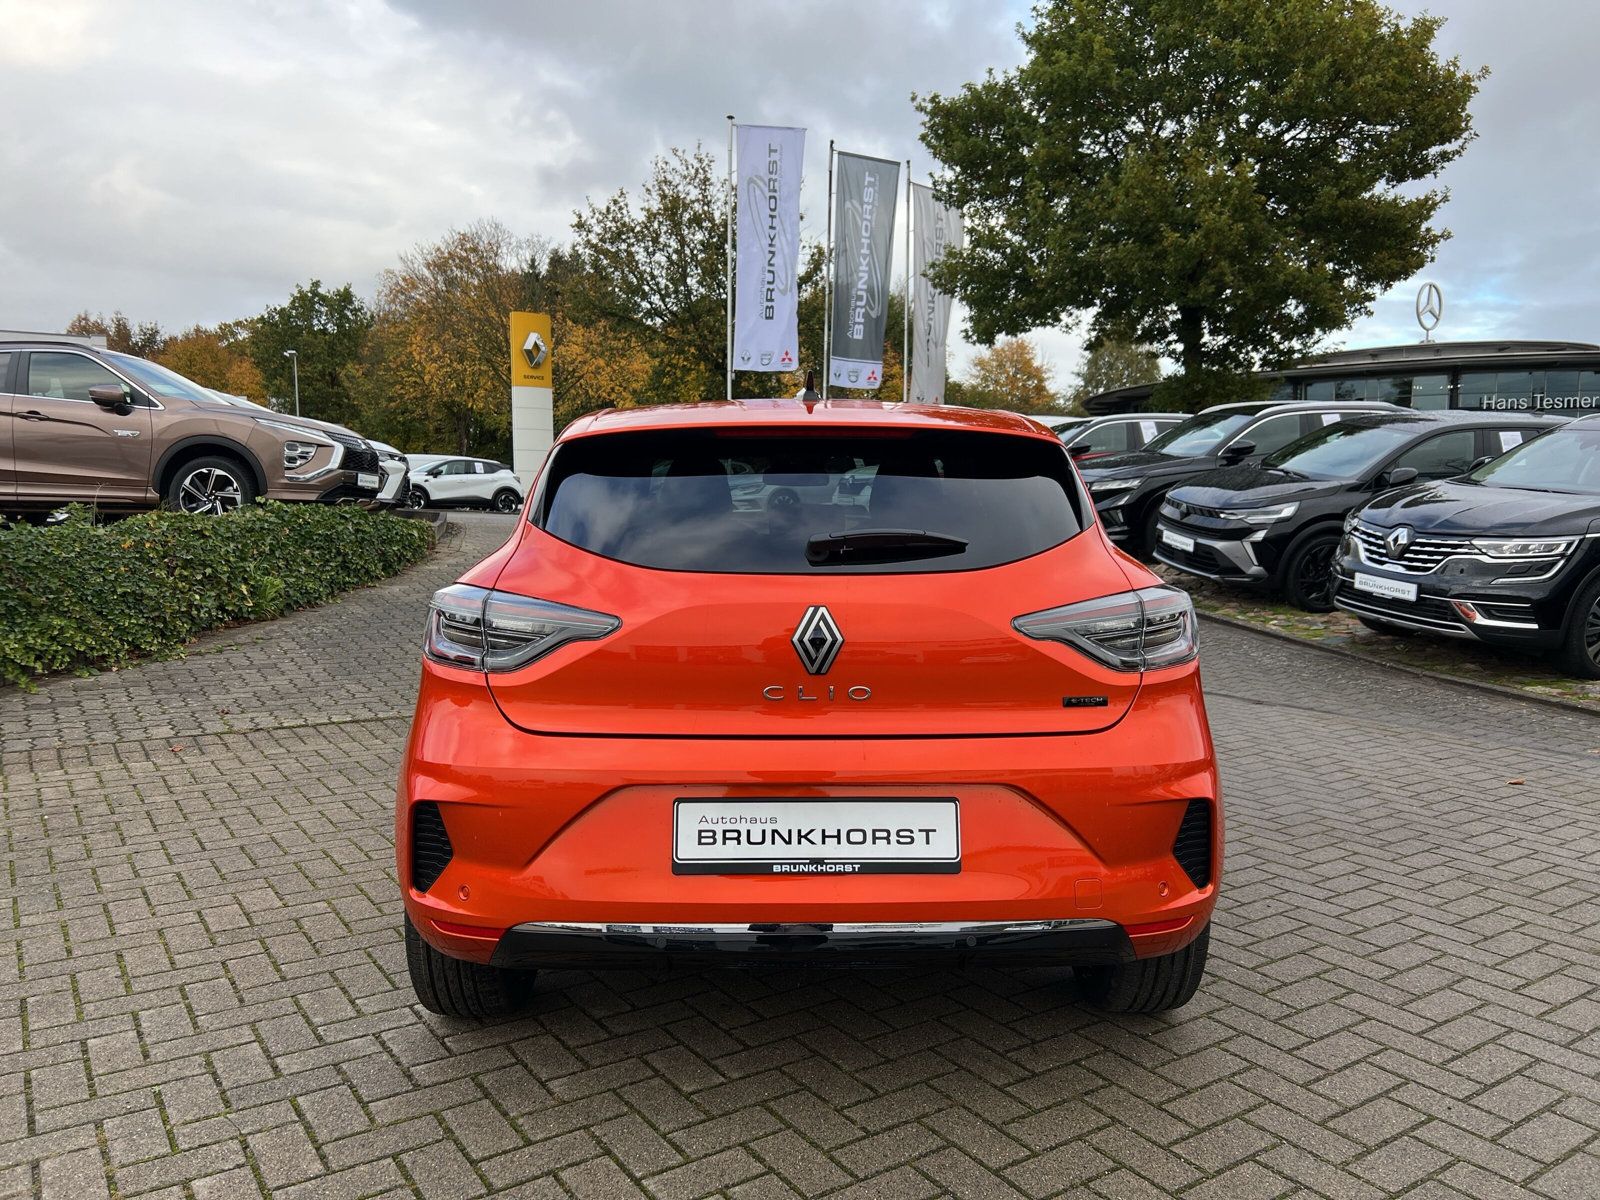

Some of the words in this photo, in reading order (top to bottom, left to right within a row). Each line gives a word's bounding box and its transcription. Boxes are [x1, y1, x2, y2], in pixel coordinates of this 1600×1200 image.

[764, 143, 778, 321] BRUNKHORST
[853, 171, 875, 340] BRUNKHORST
[846, 287, 857, 339] Autohaus
[1483, 394, 1528, 410] Hans
[1533, 393, 1600, 409] Tesmer
[1358, 580, 1411, 596] BRUNKHORST
[763, 685, 872, 700] CLIO
[698, 815, 778, 825] Autohaus
[697, 828, 937, 846] BRUNKHORST
[772, 864, 861, 873] BRUNKHORST
